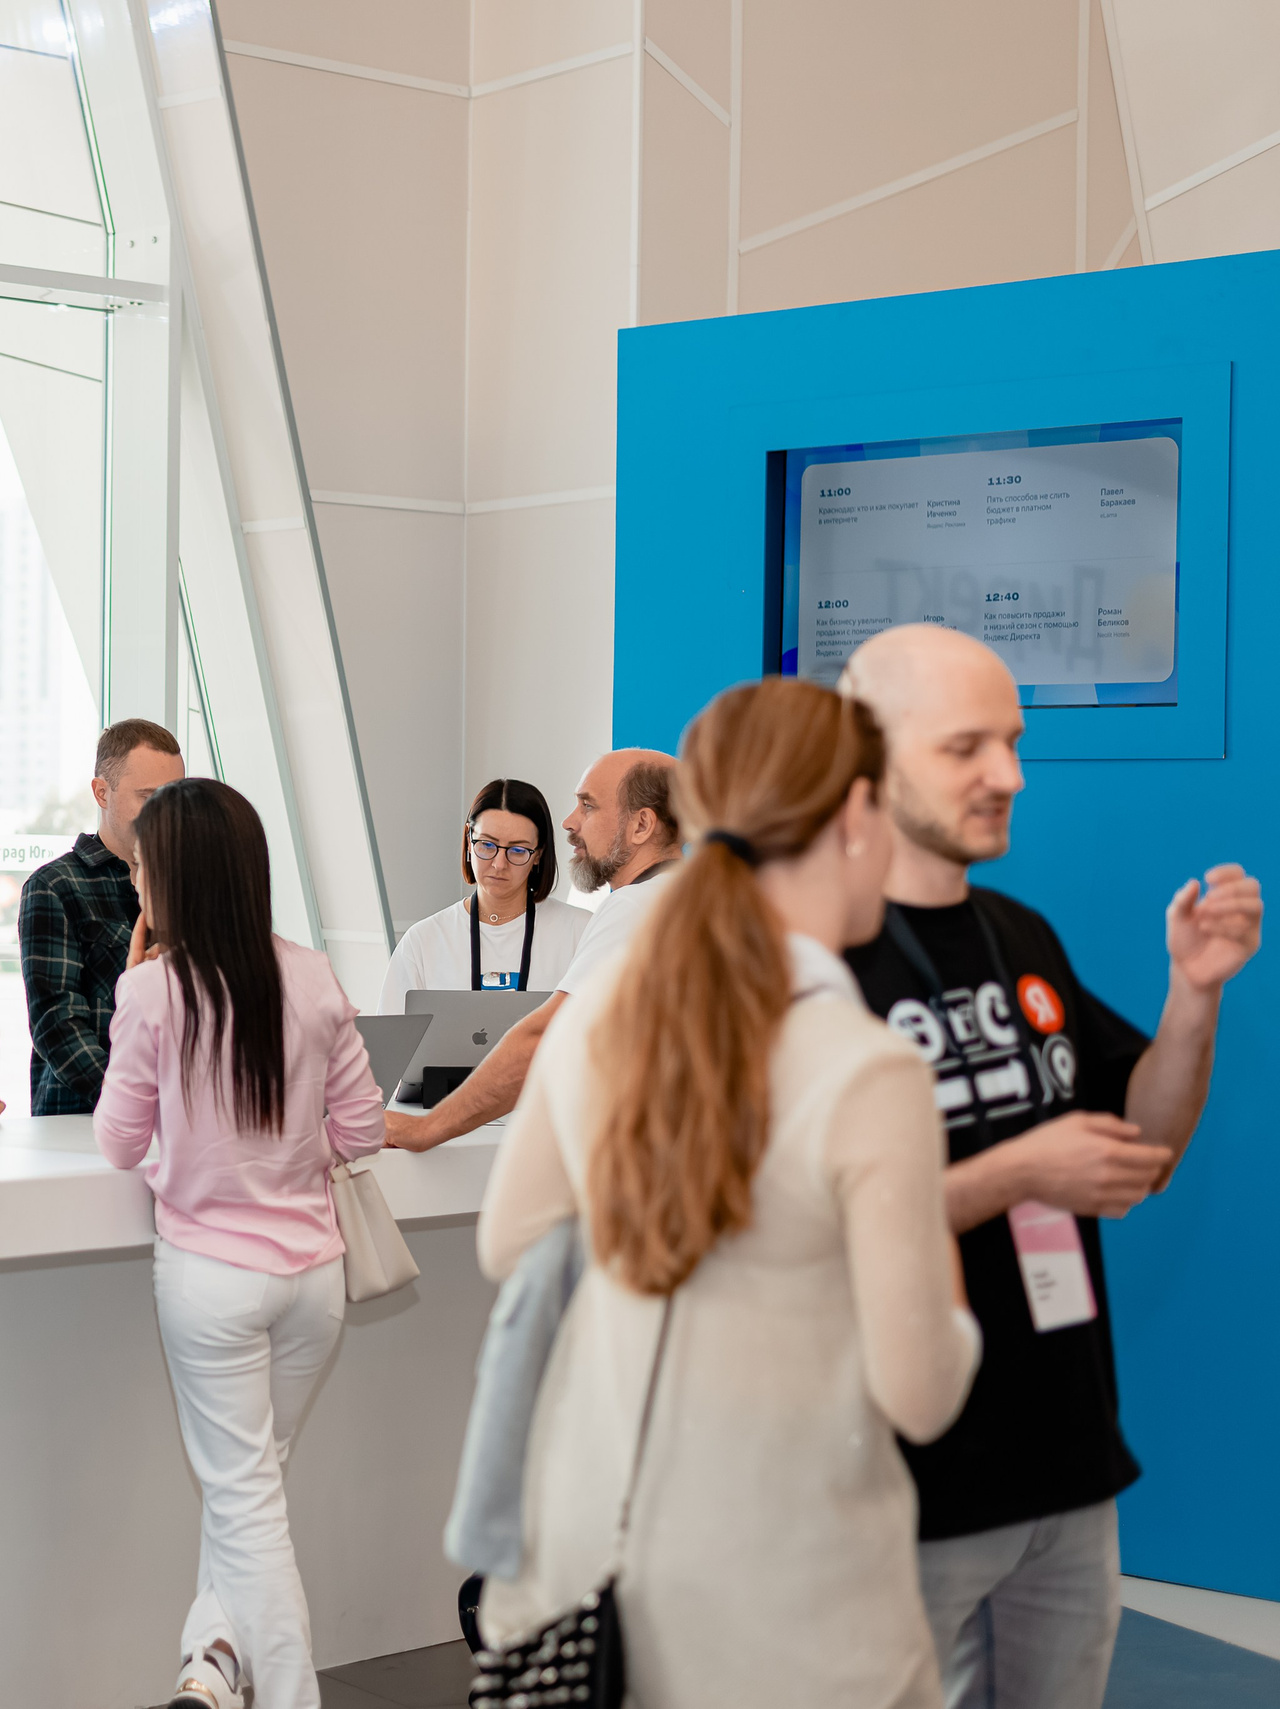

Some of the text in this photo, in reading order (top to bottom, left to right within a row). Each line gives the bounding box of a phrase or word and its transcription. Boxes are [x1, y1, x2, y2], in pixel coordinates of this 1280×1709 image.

[987, 475, 1022, 486] 11:30
[819, 487, 851, 497] 11:00
[1100, 488, 1124, 496] Павел
[986, 496, 1003, 504] Пять
[1005, 493, 1038, 503] способов
[1049, 492, 1070, 500] слить
[1100, 498, 1136, 507] Баракаев
[887, 502, 919, 512] покупает
[926, 499, 961, 508] Кристина
[926, 510, 957, 518] Ивченко
[986, 506, 1014, 515] бюджет
[1021, 504, 1052, 512] платном
[823, 517, 858, 525] интернете
[986, 516, 1016, 526] трафике
[985, 592, 1020, 602] 12:40
[817, 600, 849, 609] 12:00
[984, 612, 997, 620] Как
[1033, 610, 1066, 619] продажи
[1097, 607, 1122, 616] Роман
[829, 617, 856, 627] бизнесу
[857, 617, 892, 626] увеличить
[923, 614, 945, 623] Игорь
[1097, 619, 1130, 627] Беликов
[989, 622, 1015, 631] низкий
[1043, 621, 1079, 629] помощью
[816, 629, 846, 637] продажи
[984, 632, 1041, 642] Яндекс Директа
[816, 639, 853, 648] рекламных
[816, 649, 843, 657] Яндекса
